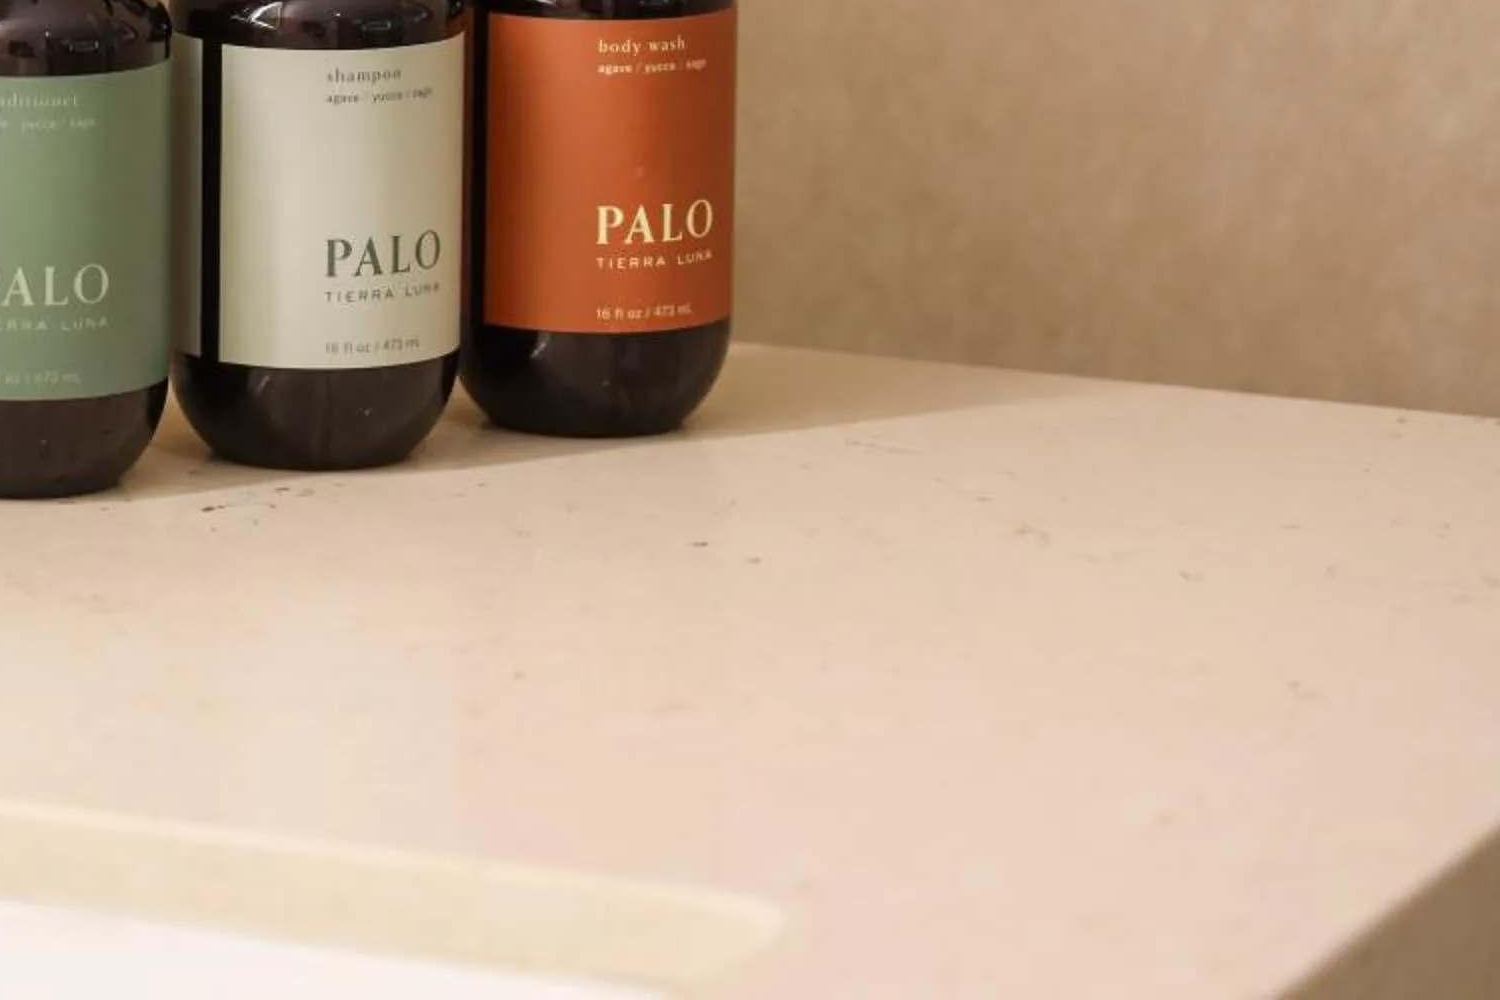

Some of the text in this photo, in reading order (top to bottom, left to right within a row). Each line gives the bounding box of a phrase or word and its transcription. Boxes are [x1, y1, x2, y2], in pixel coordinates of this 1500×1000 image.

[599, 34, 685, 56] body wash
[327, 67, 402, 84] shampoo
[596, 199, 713, 245] PALO
[326, 230, 441, 277] PALO
[596, 250, 713, 270] TIERRA LUNA
[325, 282, 440, 303] TIERRA LUNA
